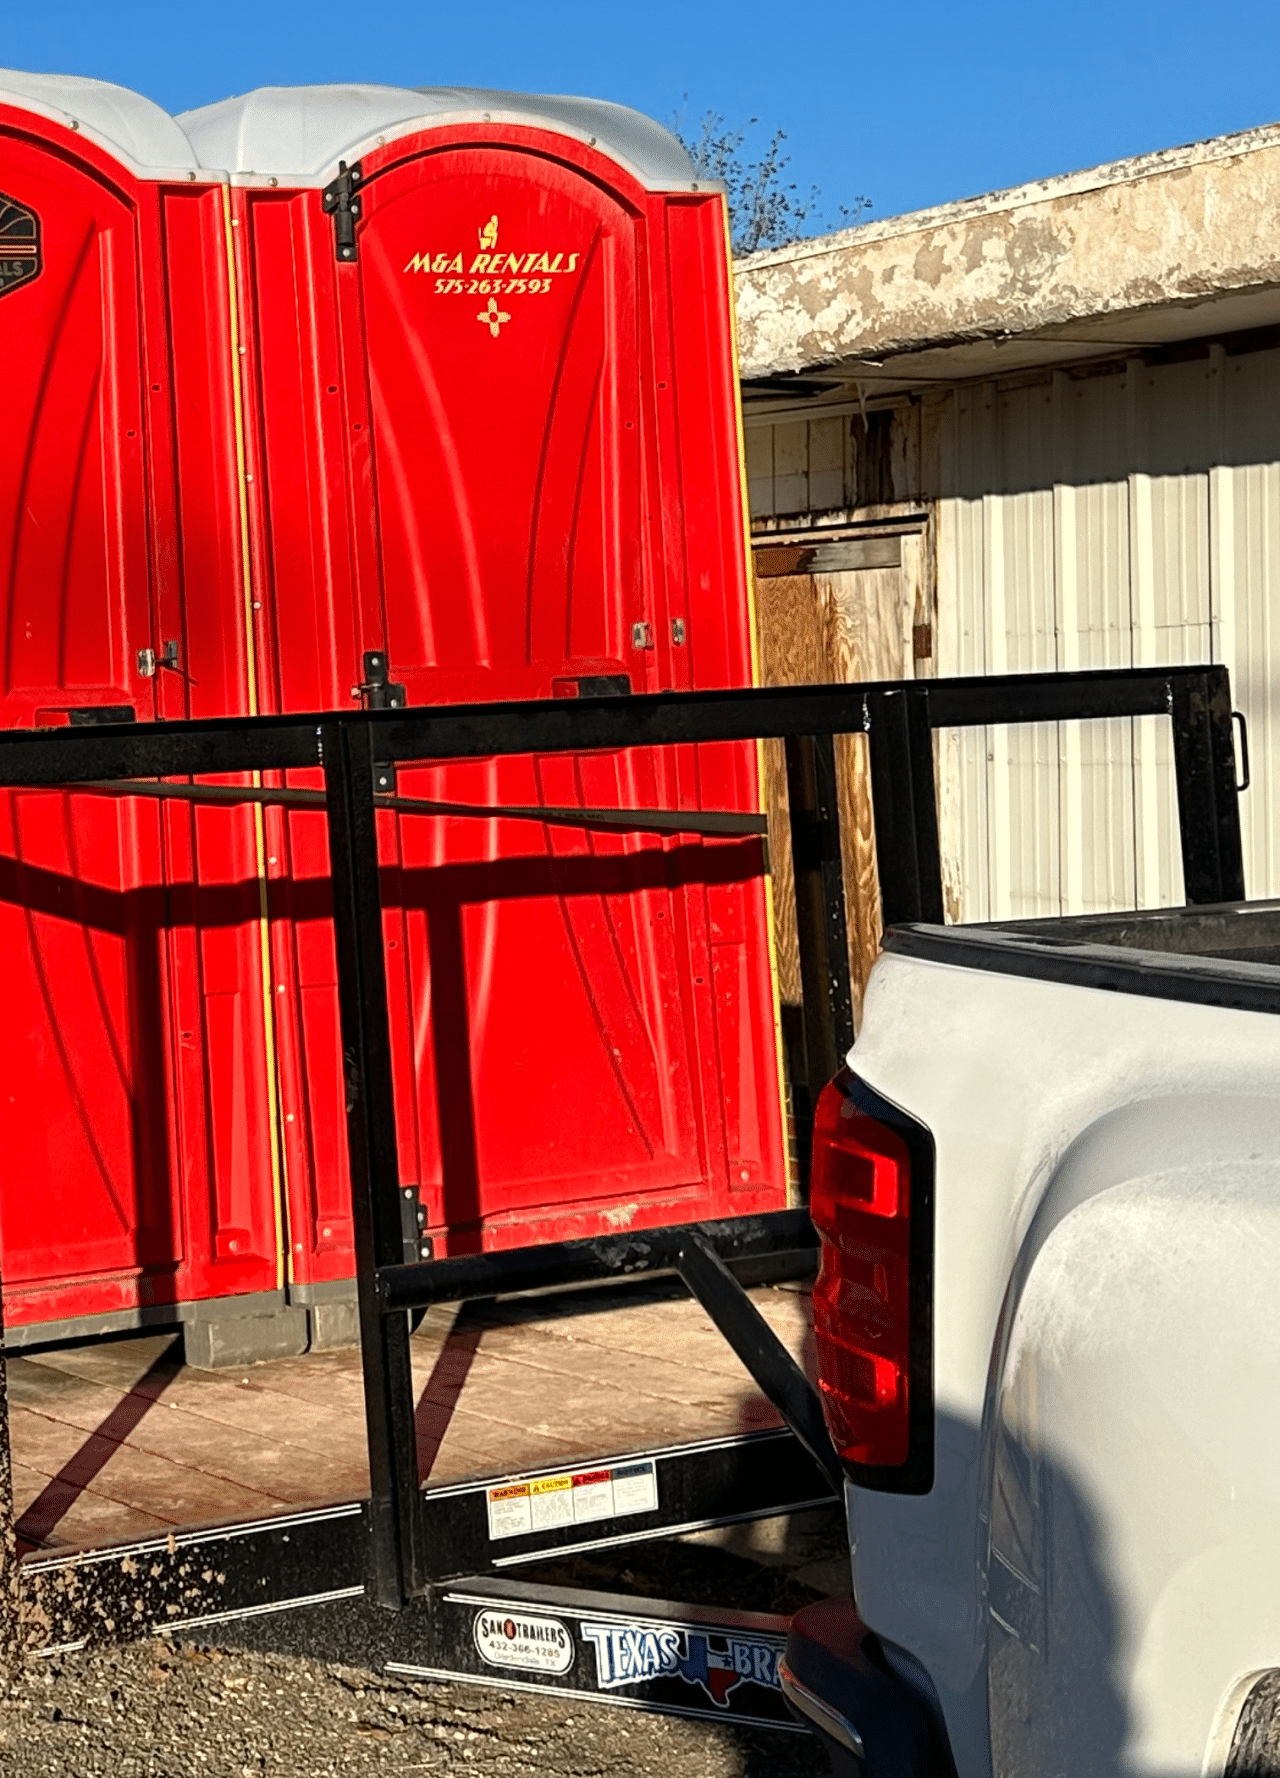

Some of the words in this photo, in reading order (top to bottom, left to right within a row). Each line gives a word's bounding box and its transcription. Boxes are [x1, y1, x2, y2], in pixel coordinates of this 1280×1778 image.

[402, 250, 463, 274] M&A
[468, 249, 581, 276] RENTALS
[516, 1621, 566, 1649] TRAILERS
[582, 1625, 680, 1684] TEXAS
